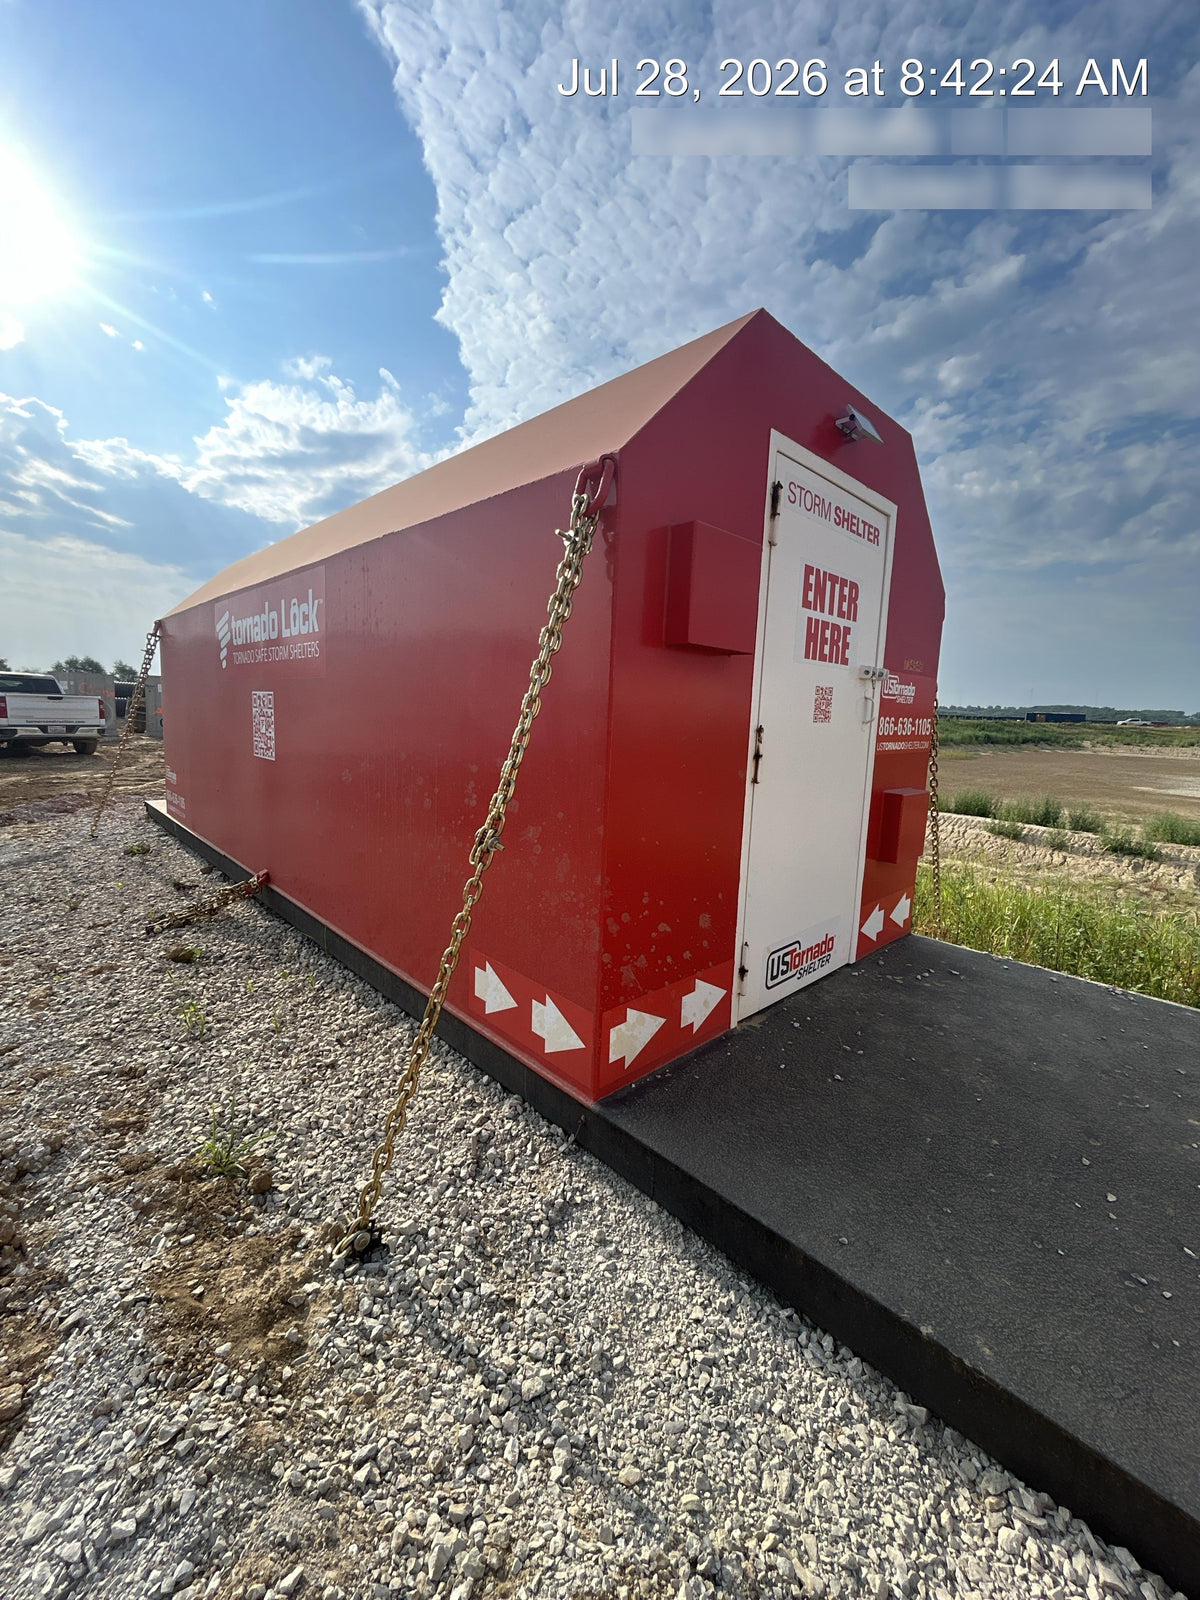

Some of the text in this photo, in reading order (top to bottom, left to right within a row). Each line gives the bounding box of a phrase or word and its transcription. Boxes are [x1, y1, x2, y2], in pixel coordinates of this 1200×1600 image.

[788, 481, 880, 546] STORM SHELTER
[801, 563, 860, 622] ENTER
[231, 601, 278, 646] tornado
[804, 616, 851, 666] HERE
[233, 641, 320, 664] TORNADO SAFE STORM SHELTERS
[879, 717, 931, 735] 866-636-1105
[797, 953, 832, 980] SHELTER
